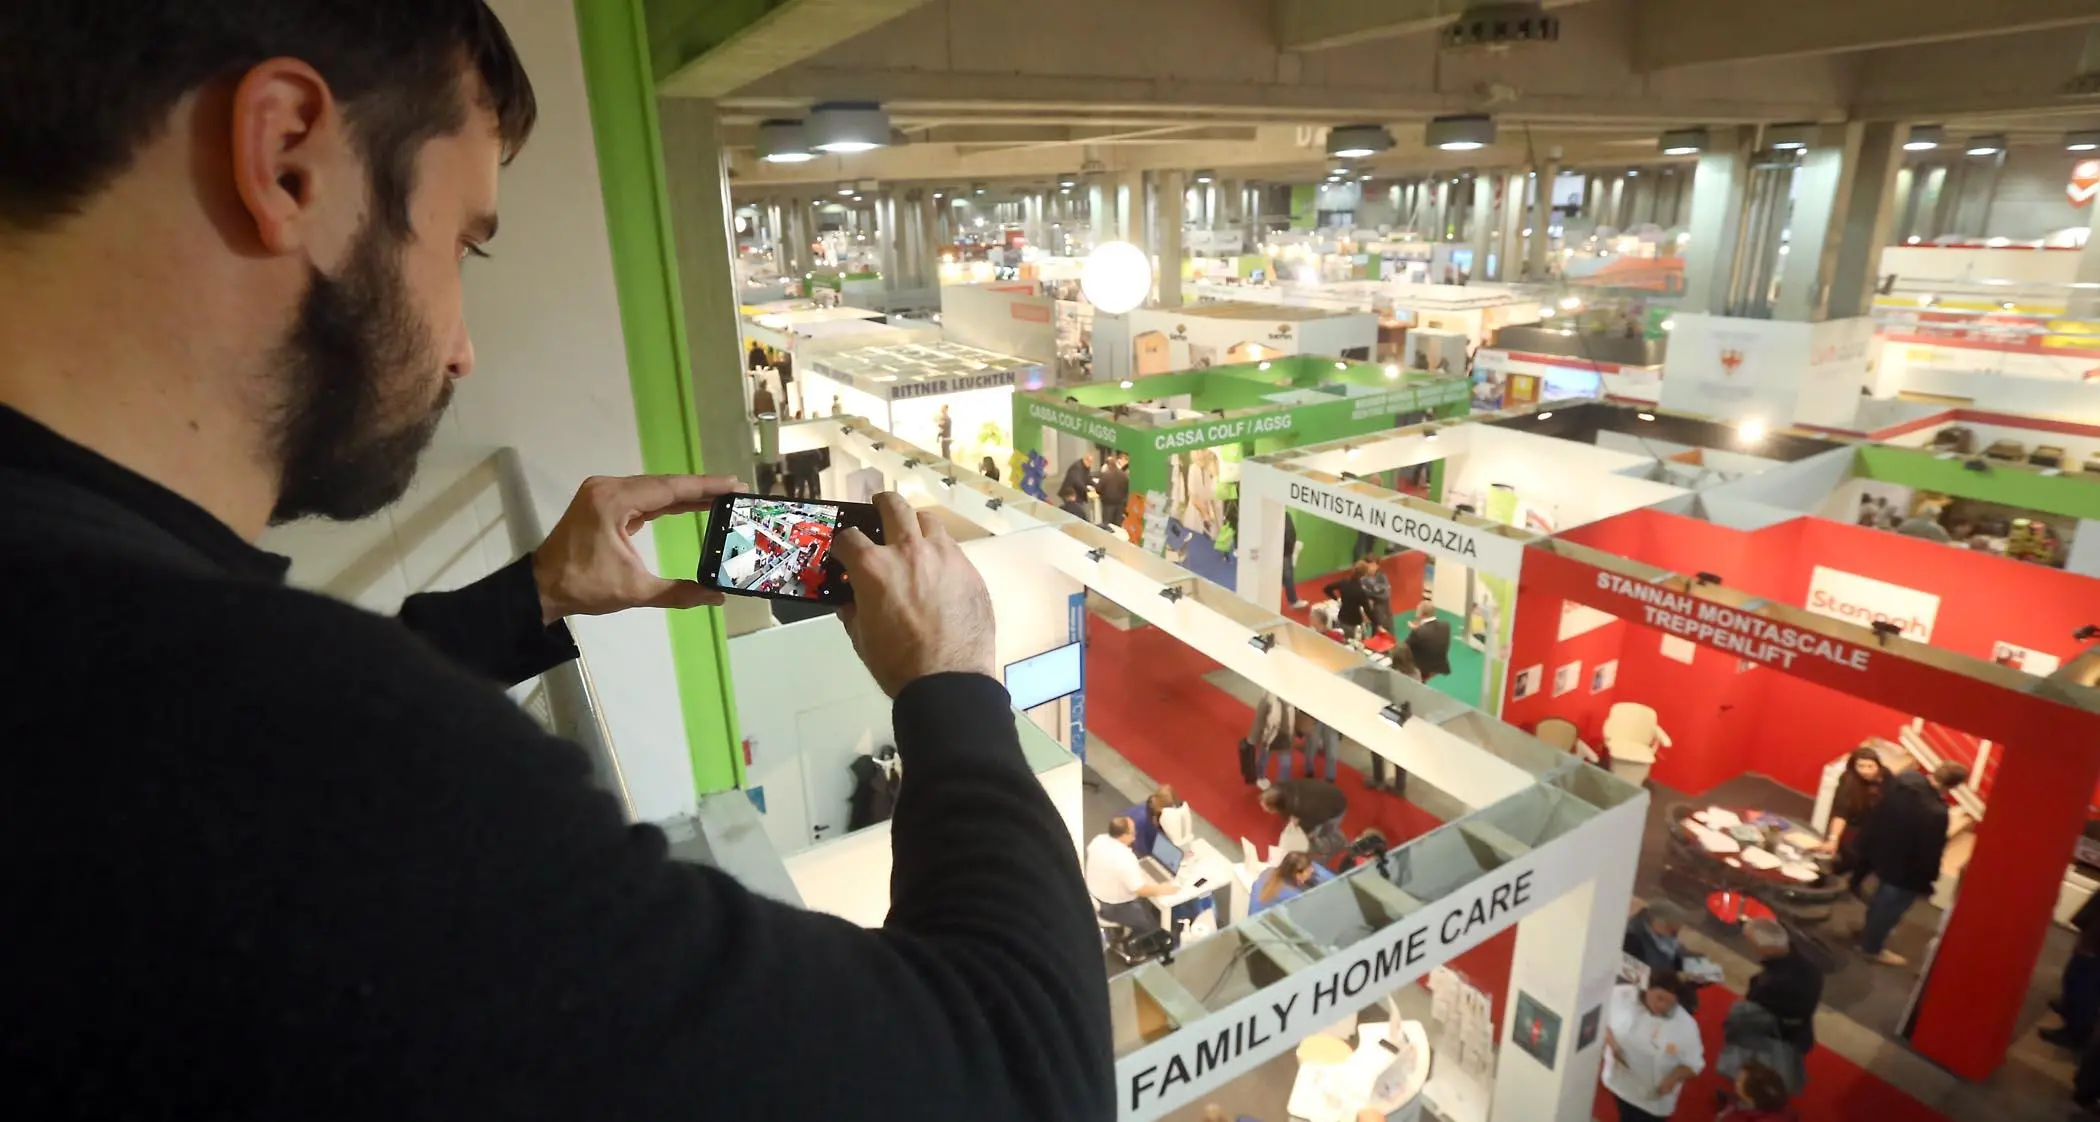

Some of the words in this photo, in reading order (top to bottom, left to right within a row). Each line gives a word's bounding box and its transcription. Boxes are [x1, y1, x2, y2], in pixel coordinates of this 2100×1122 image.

[891, 379, 948, 399] RITTNER
[952, 371, 1016, 391] LEUCHTEN
[1029, 403, 1058, 426] CASSA
[1057, 413, 1082, 432] COLF
[1087, 421, 1118, 444] AGSG
[1155, 429, 1205, 451] CASSA
[1208, 420, 1245, 441] COLF
[1253, 414, 1293, 433] AGSG
[1290, 482, 1365, 521] DENTISTA
[1369, 507, 1386, 528] IN
[1391, 514, 1478, 558] CROAZIA
[1597, 571, 1693, 614] STANNAH
[1697, 603, 1872, 671] MONTASCALE
[1643, 605, 1798, 669] TREPPENLIFT
[1131, 993, 1299, 1112] FAMILY
[1313, 926, 1429, 1015] HOME
[1440, 870, 1534, 946] CARE
